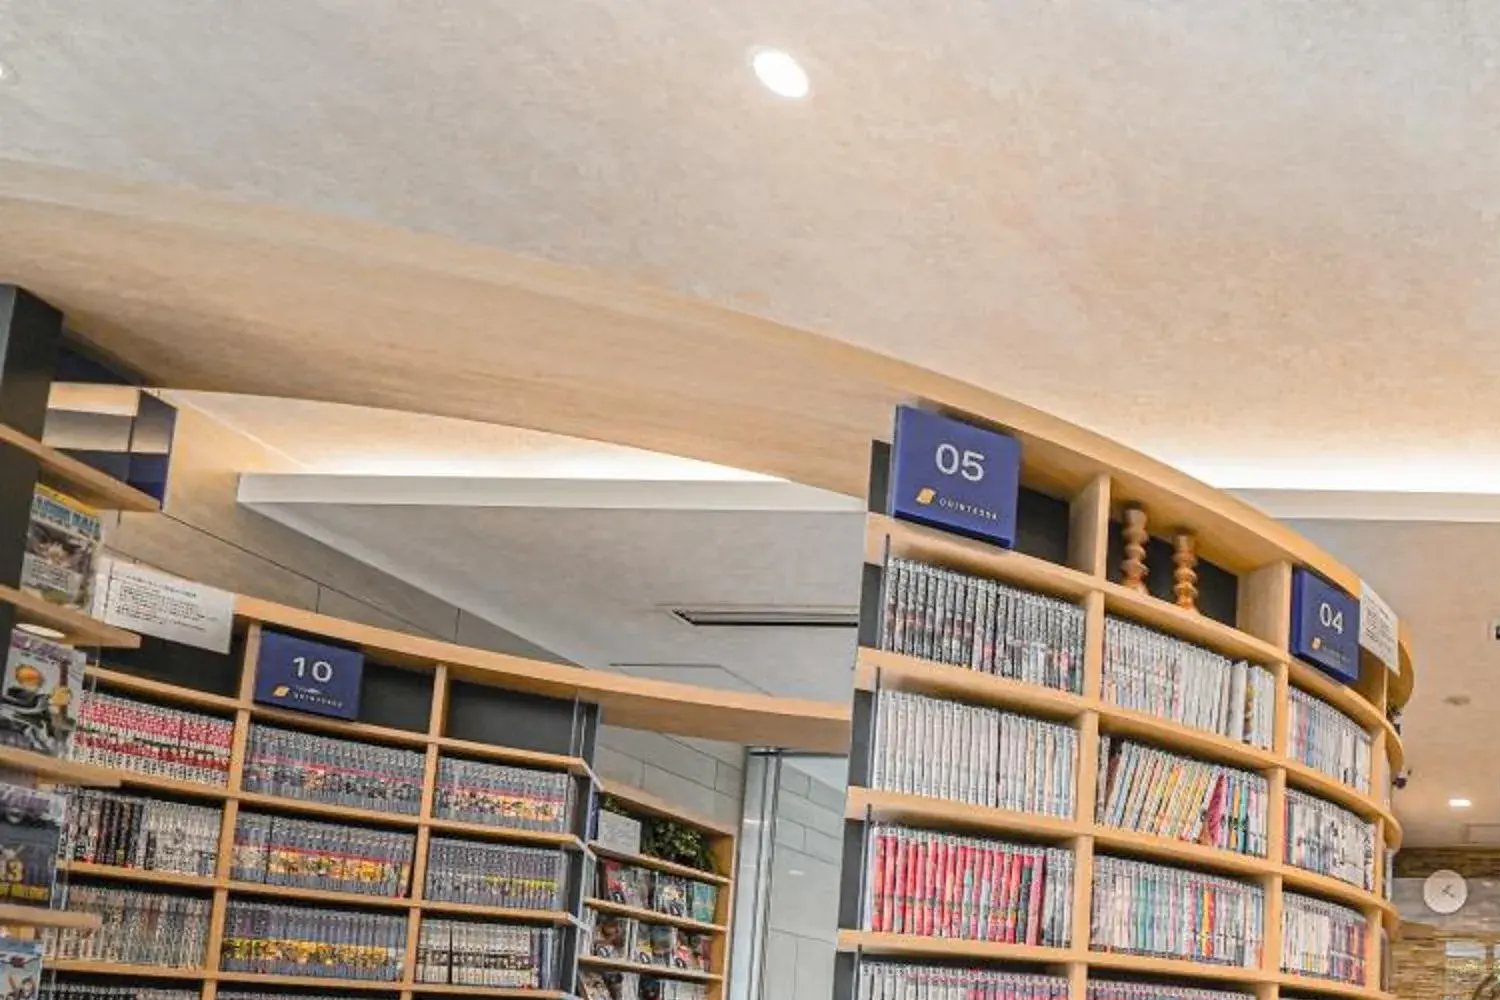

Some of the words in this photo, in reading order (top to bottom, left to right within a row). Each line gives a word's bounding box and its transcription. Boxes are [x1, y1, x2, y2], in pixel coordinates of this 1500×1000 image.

[935, 443, 985, 482] 05
[1319, 602, 1344, 634] 04
[293, 656, 332, 683] 10
